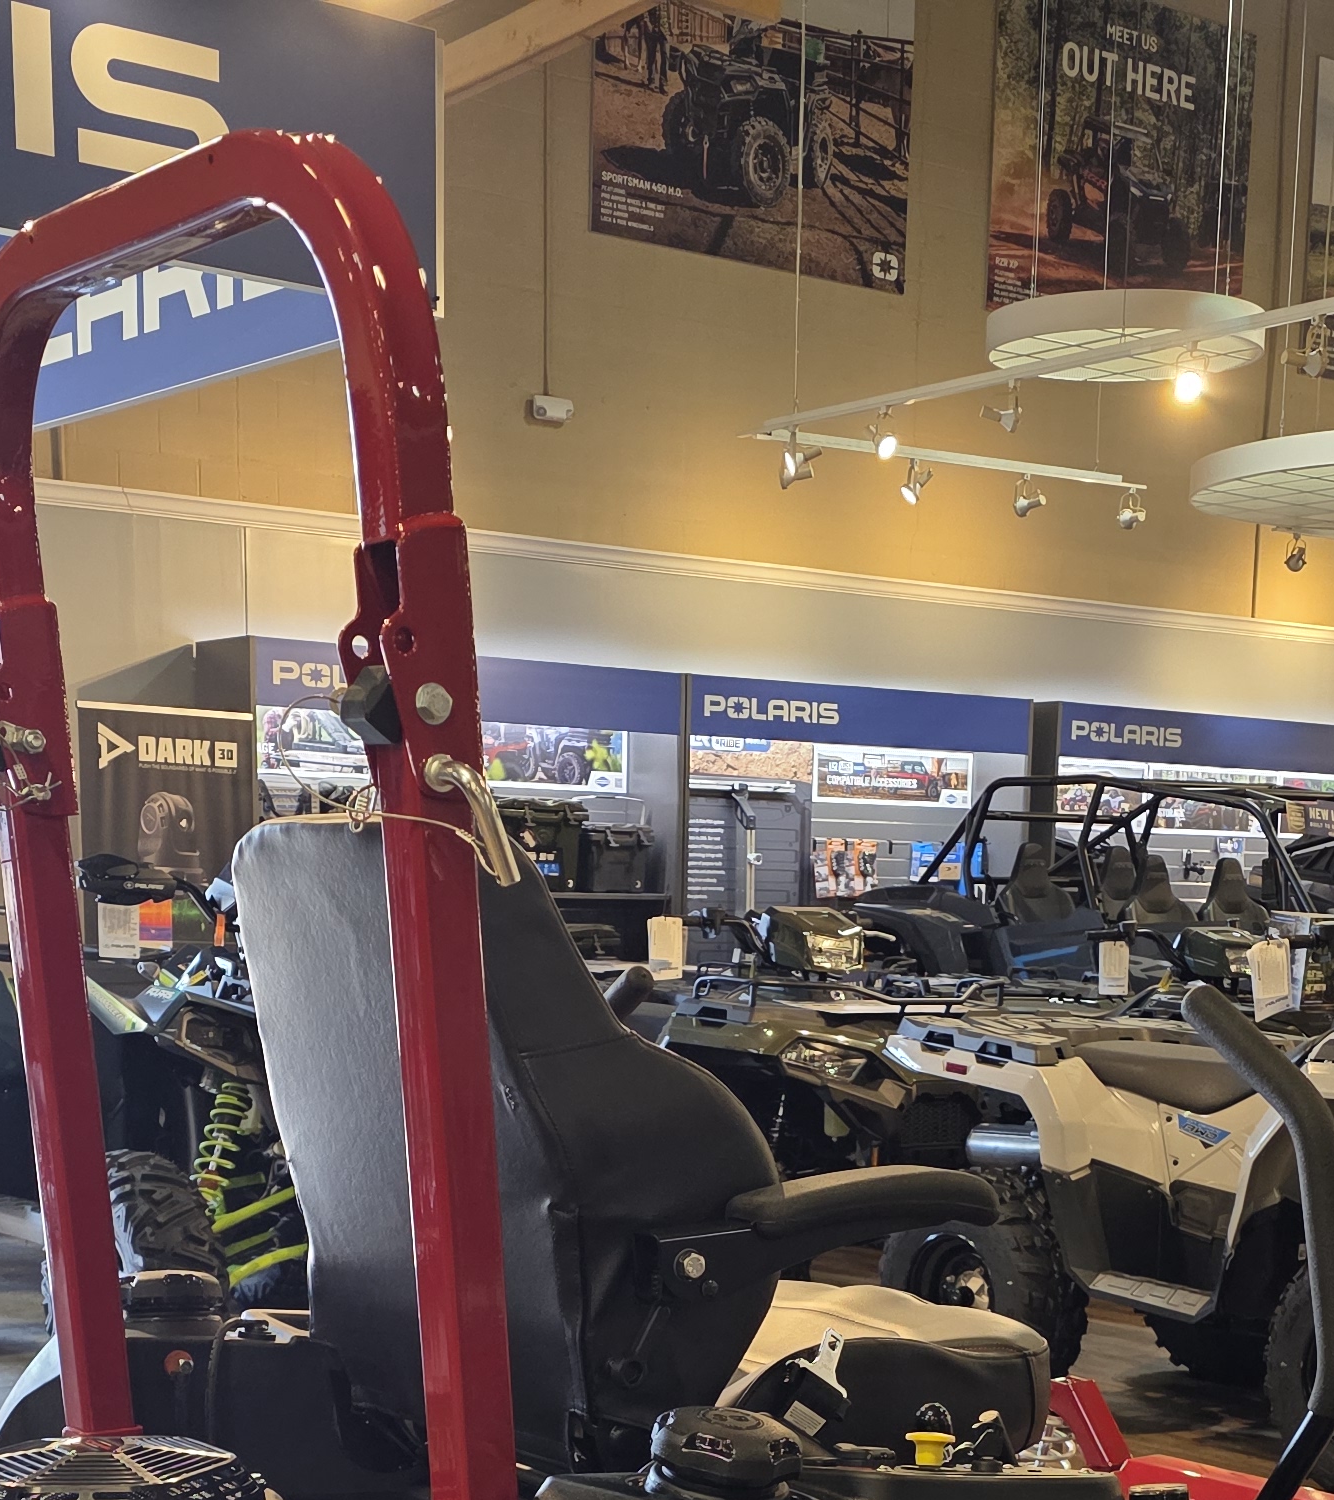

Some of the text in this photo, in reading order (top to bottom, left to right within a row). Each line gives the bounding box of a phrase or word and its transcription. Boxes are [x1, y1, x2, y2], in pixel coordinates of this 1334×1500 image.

[1107, 23, 1158, 53] MEET US
[1062, 41, 1196, 111] OUT HERE
[601, 170, 651, 191] SPORTSMAN
[652, 183, 667, 194] 450
[703, 694, 840, 725] POLARIS
[1071, 719, 1183, 748] POLARIS
[137, 735, 212, 766] DARK
[1308, 807, 1329, 821] NEW
